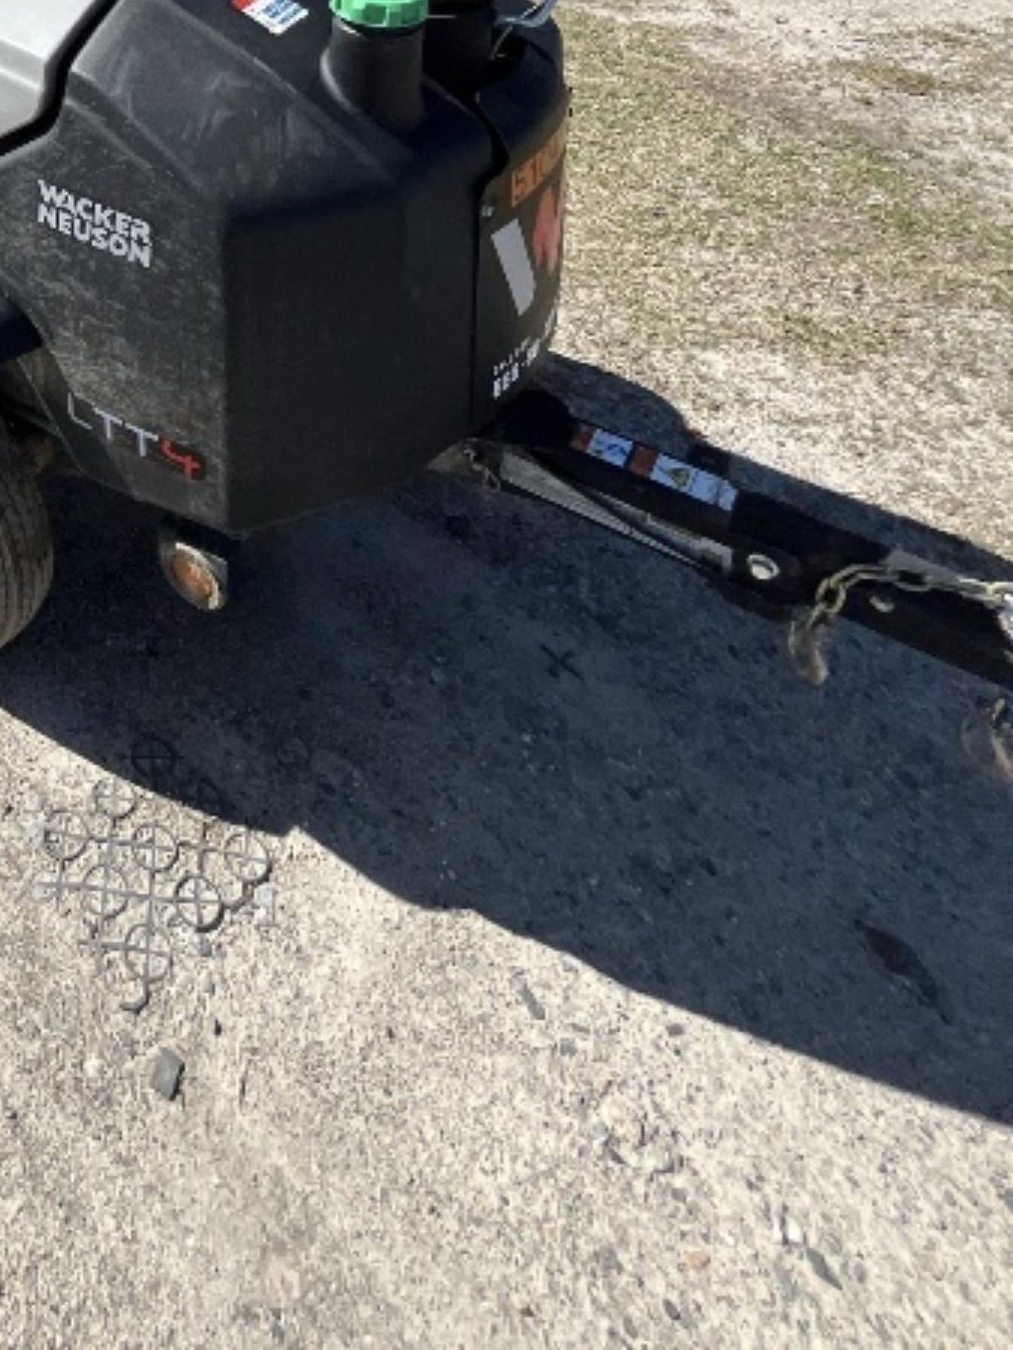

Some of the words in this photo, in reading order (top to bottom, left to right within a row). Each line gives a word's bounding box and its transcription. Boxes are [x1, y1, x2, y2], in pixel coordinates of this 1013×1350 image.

[38, 179, 152, 246] WACKER
[38, 203, 152, 268] NEUSON
[67, 392, 202, 480] LTT4
